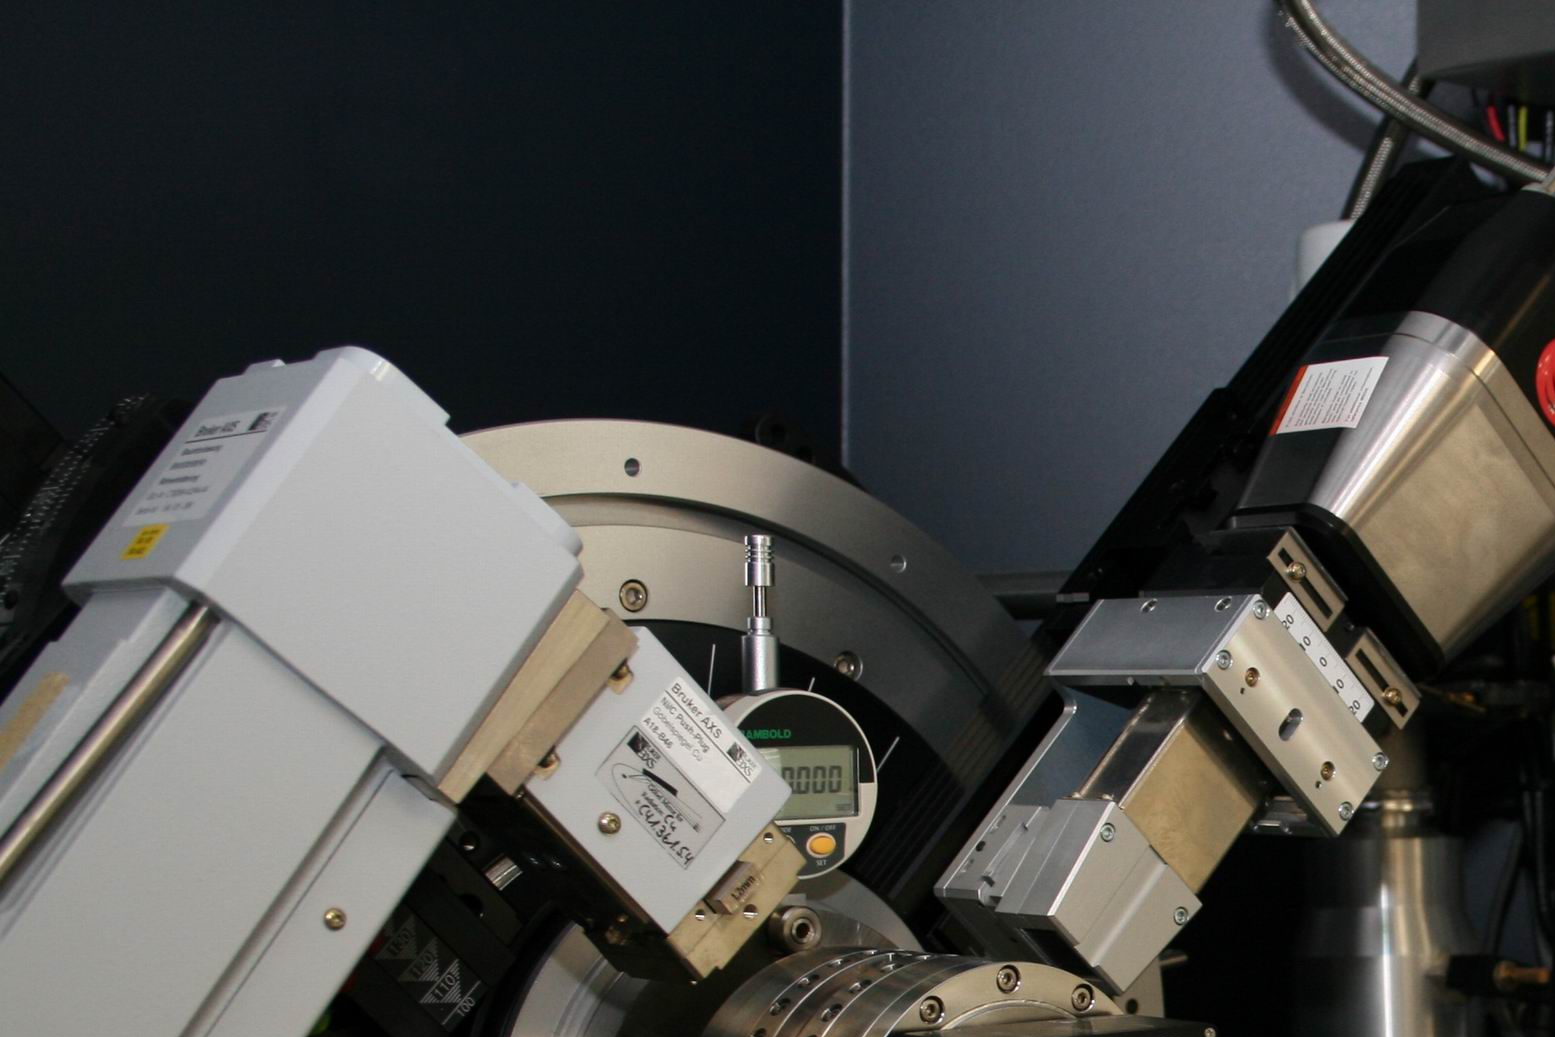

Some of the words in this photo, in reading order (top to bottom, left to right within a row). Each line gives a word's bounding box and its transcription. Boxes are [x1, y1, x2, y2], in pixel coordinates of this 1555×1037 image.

[1281, 614, 1294, 630] 20
[1319, 656, 1328, 667] 0
[671, 683, 703, 717] Bruker
[701, 717, 722, 739] AXS
[1348, 700, 1361, 715] 20
[743, 729, 792, 740] AMBOLD
[433, 974, 456, 998] 110
[456, 996, 477, 1017] 100
